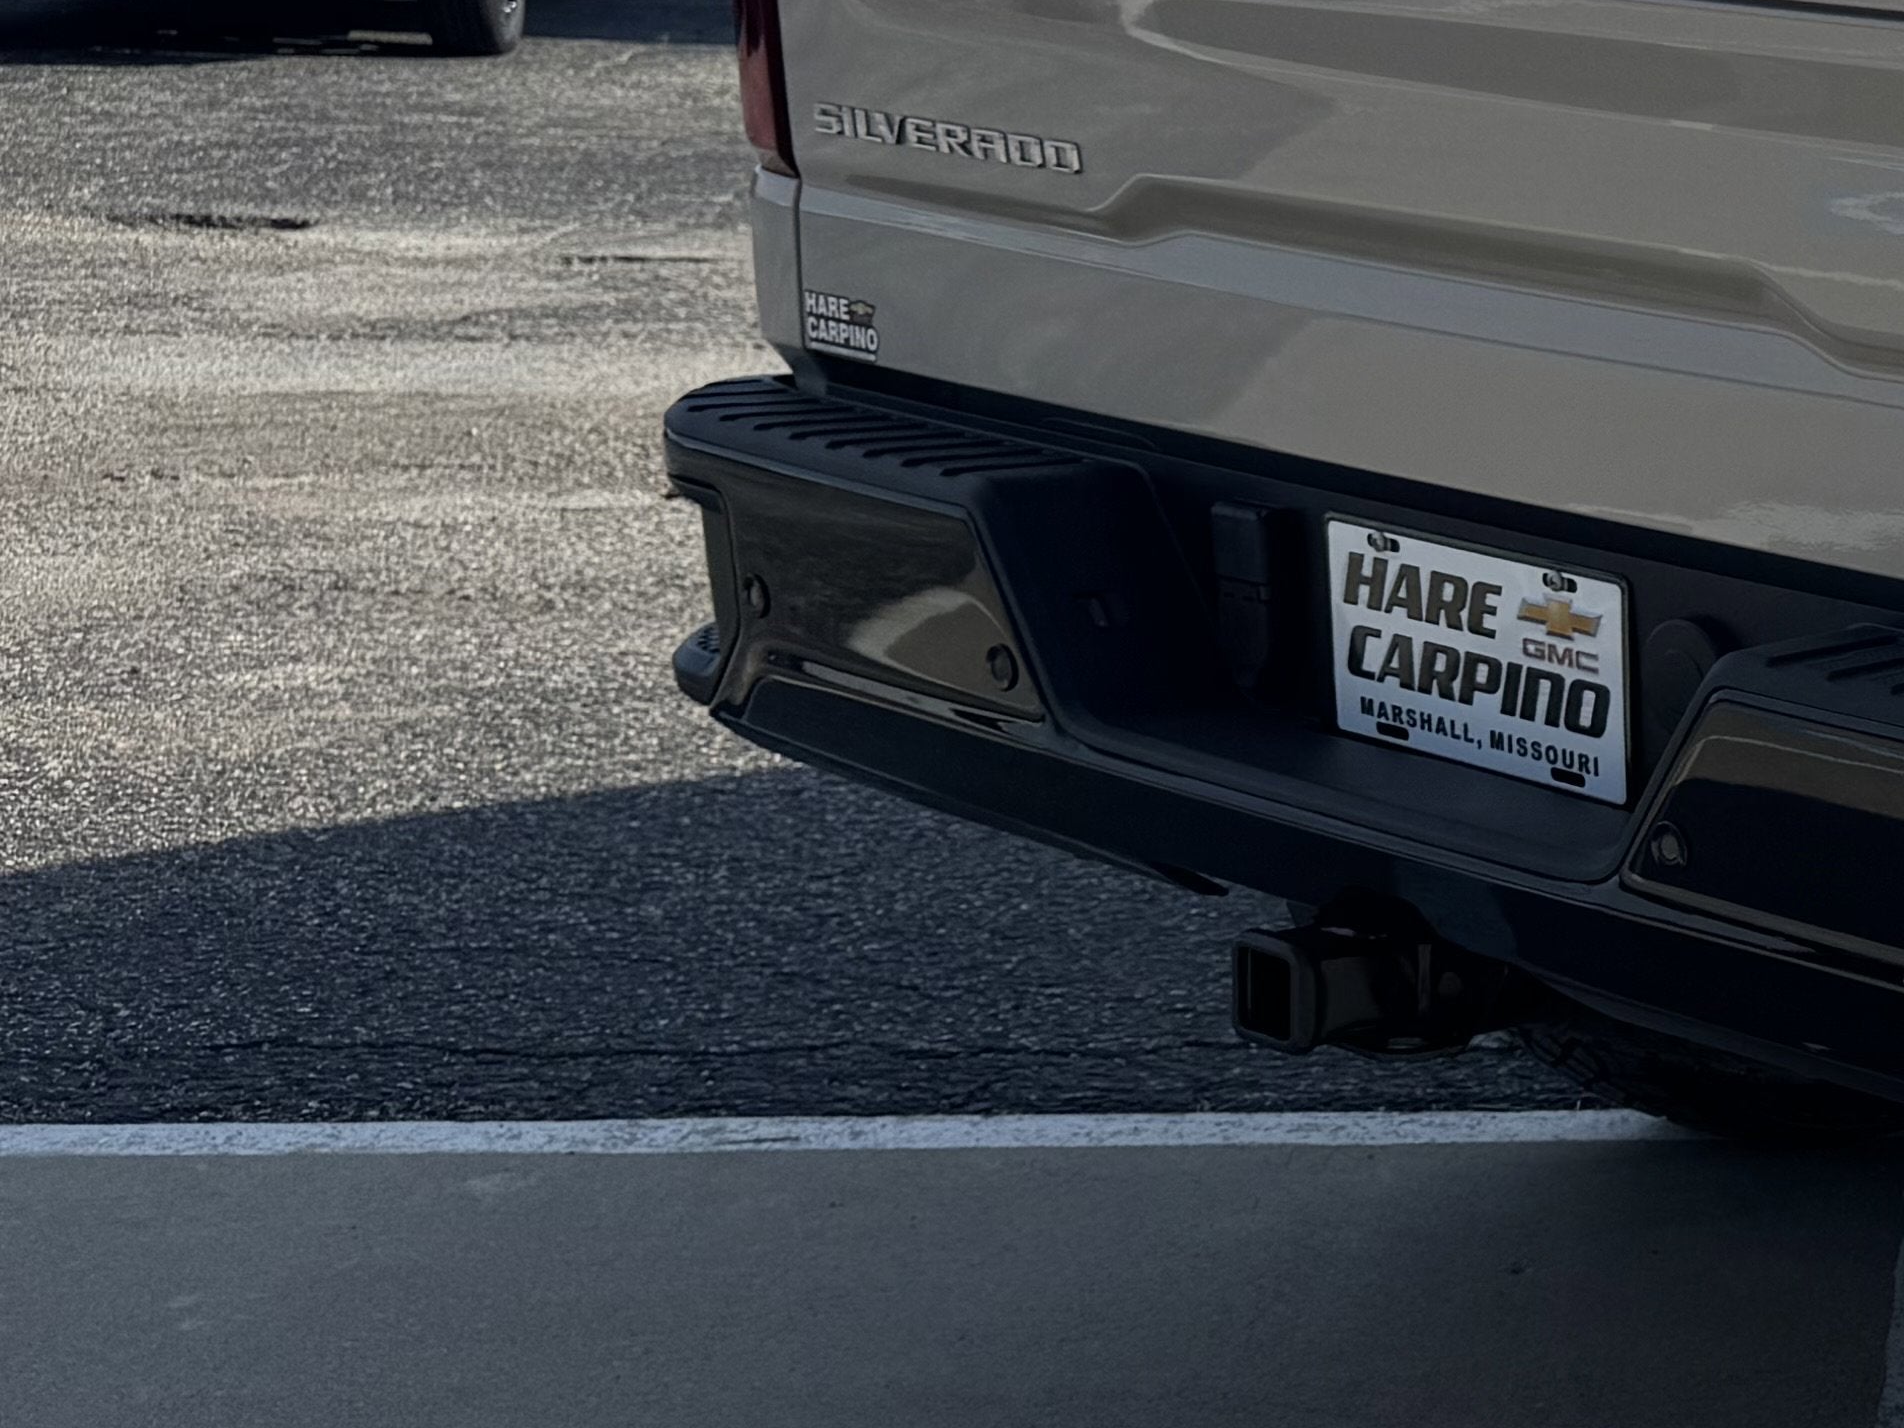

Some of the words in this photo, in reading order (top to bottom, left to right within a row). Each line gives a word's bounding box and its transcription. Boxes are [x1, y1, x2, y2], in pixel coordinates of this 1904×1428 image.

[812, 102, 1083, 173] SILVERADO
[804, 291, 850, 321] HARE
[807, 316, 879, 352] CARPINO
[1343, 551, 1503, 639] HARE
[1346, 624, 1612, 739] CARPINO
[1521, 637, 1600, 674] GMC
[1360, 696, 1484, 751] MARSHALL,
[1489, 729, 1601, 778] MISSOURI
